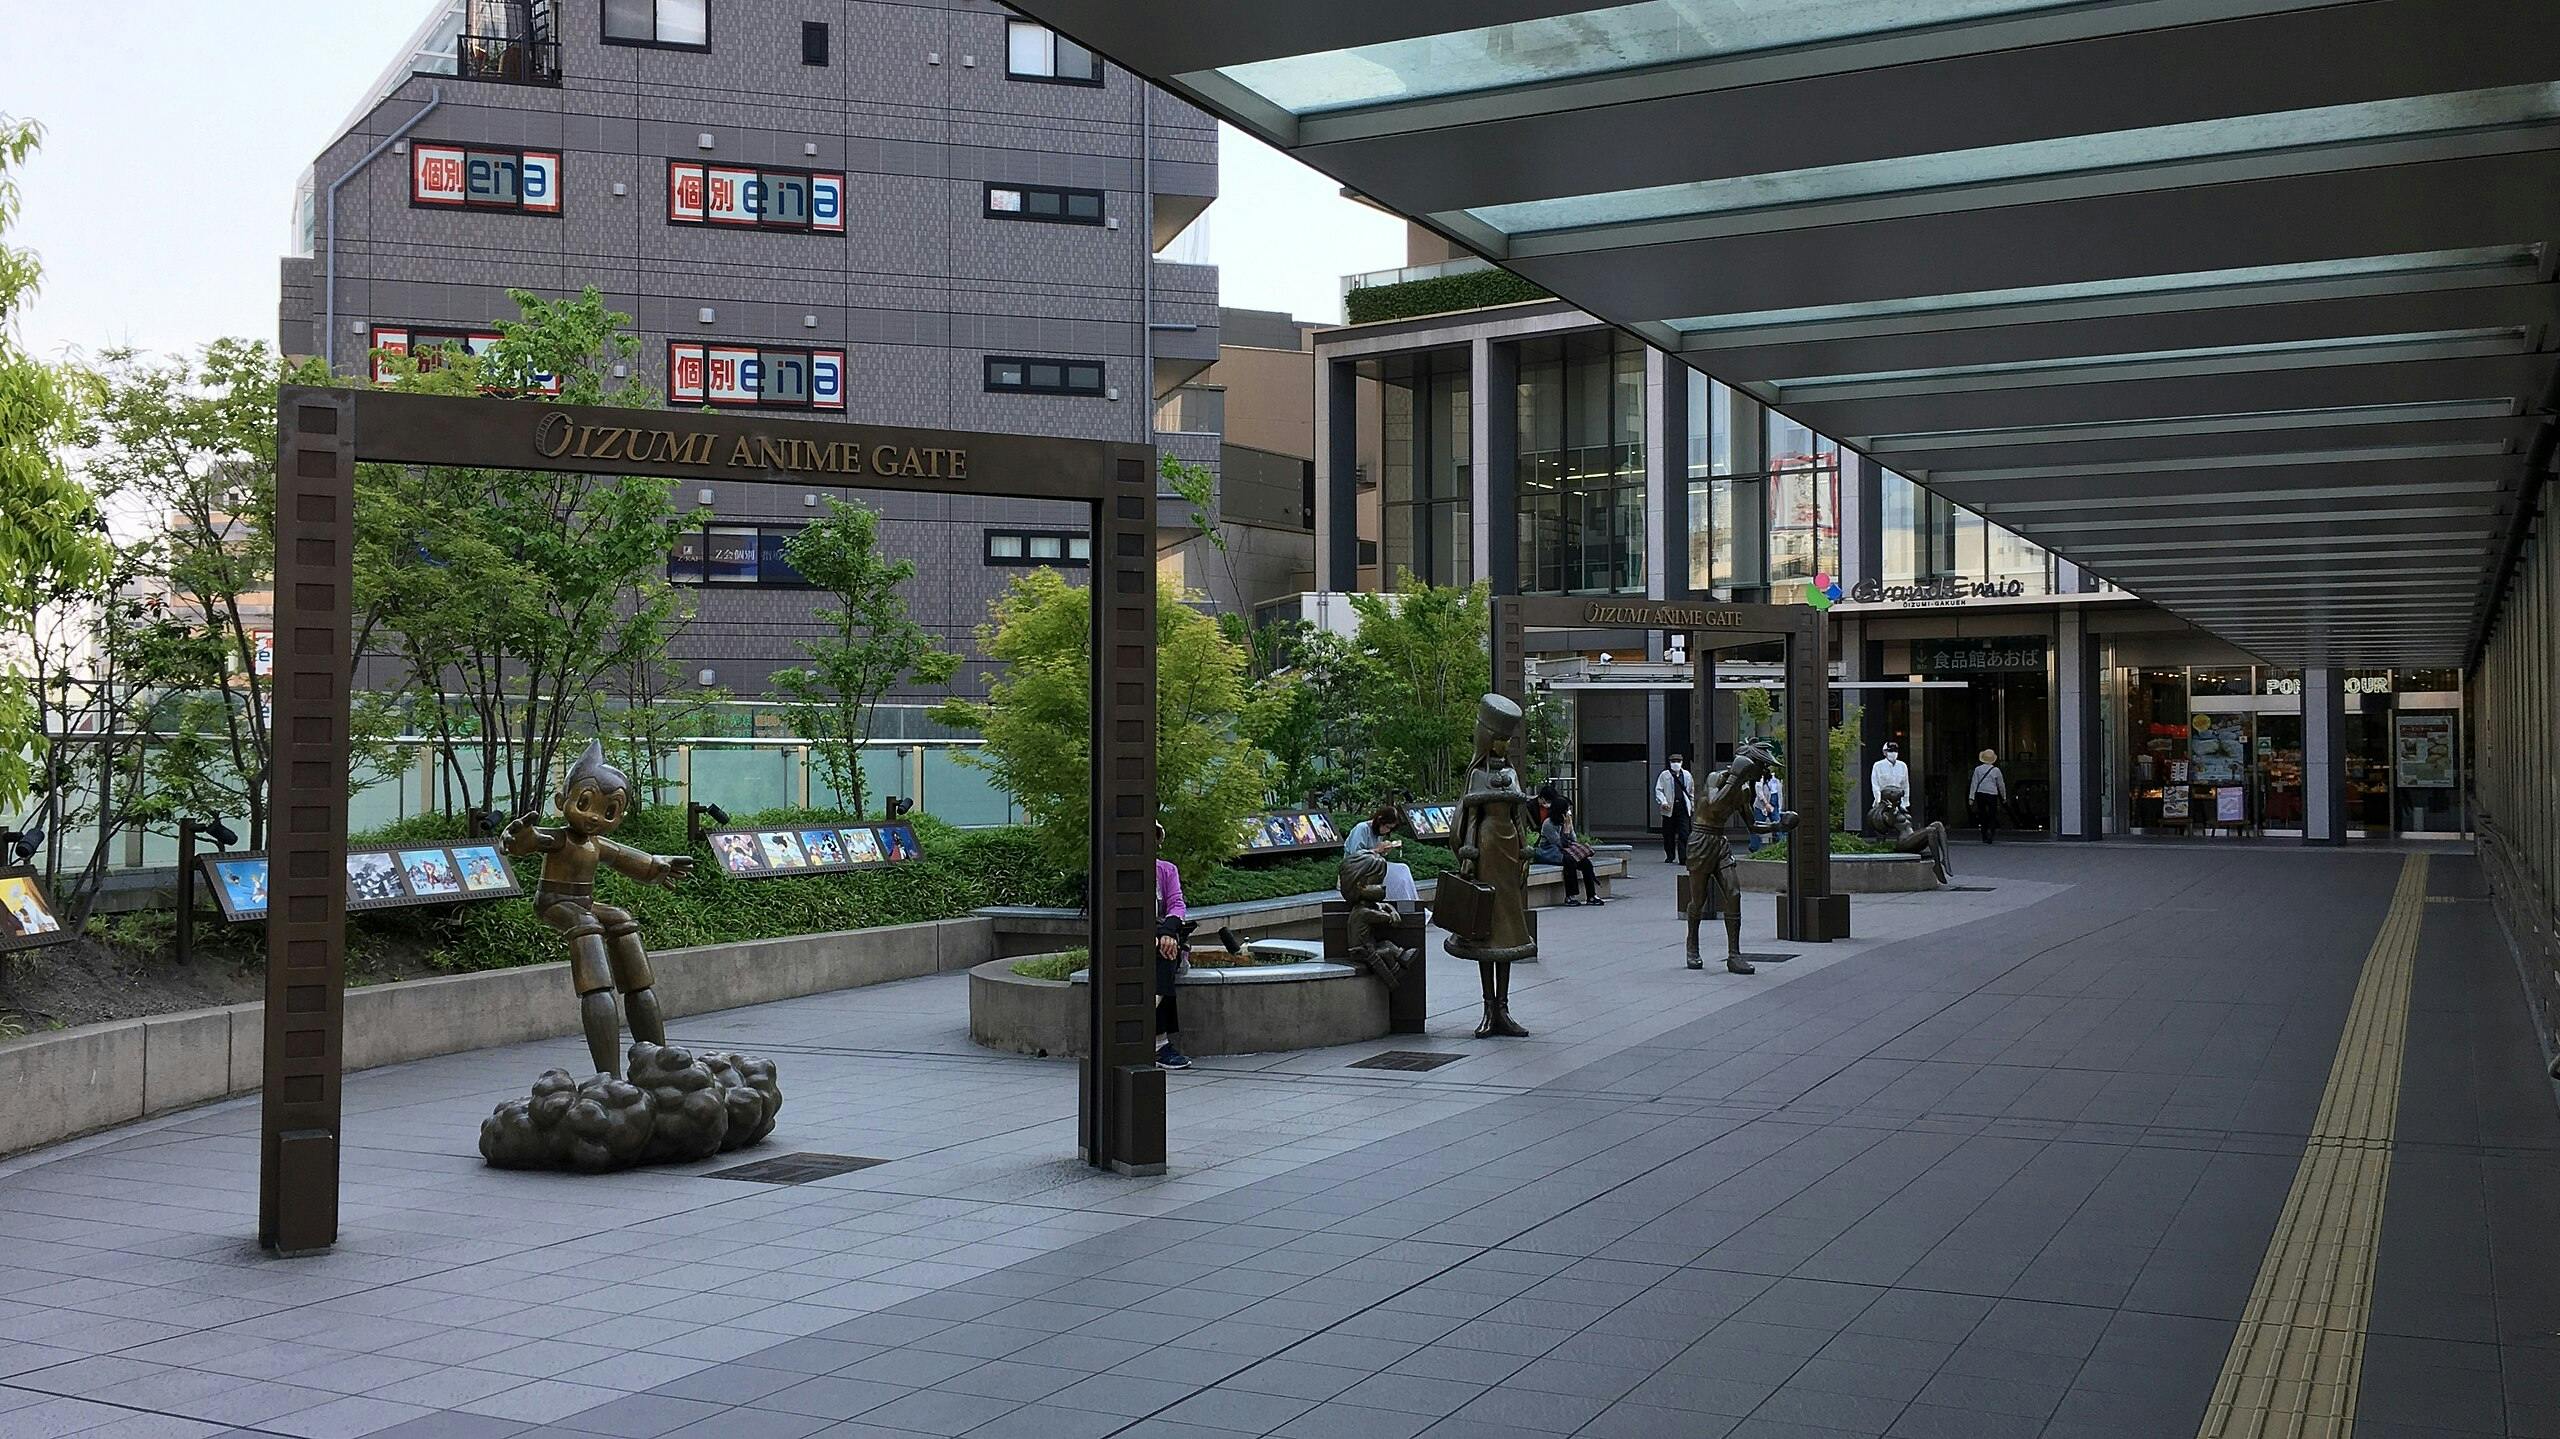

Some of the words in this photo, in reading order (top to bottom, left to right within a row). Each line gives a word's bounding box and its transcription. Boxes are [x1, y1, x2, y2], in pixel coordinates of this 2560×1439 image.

[421, 157, 464, 192] 個別
[677, 175, 734, 211] 個別
[677, 356, 735, 391] 個別
[535, 411, 718, 465] OIZUMI
[727, 435, 861, 473] ANIME
[870, 444, 968, 480] GATE
[1584, 600, 1649, 623] OIZUMI
[1653, 607, 1702, 625] ANIME
[1706, 610, 1743, 626] GATE
[1933, 650, 2040, 669] 食品館あおば
